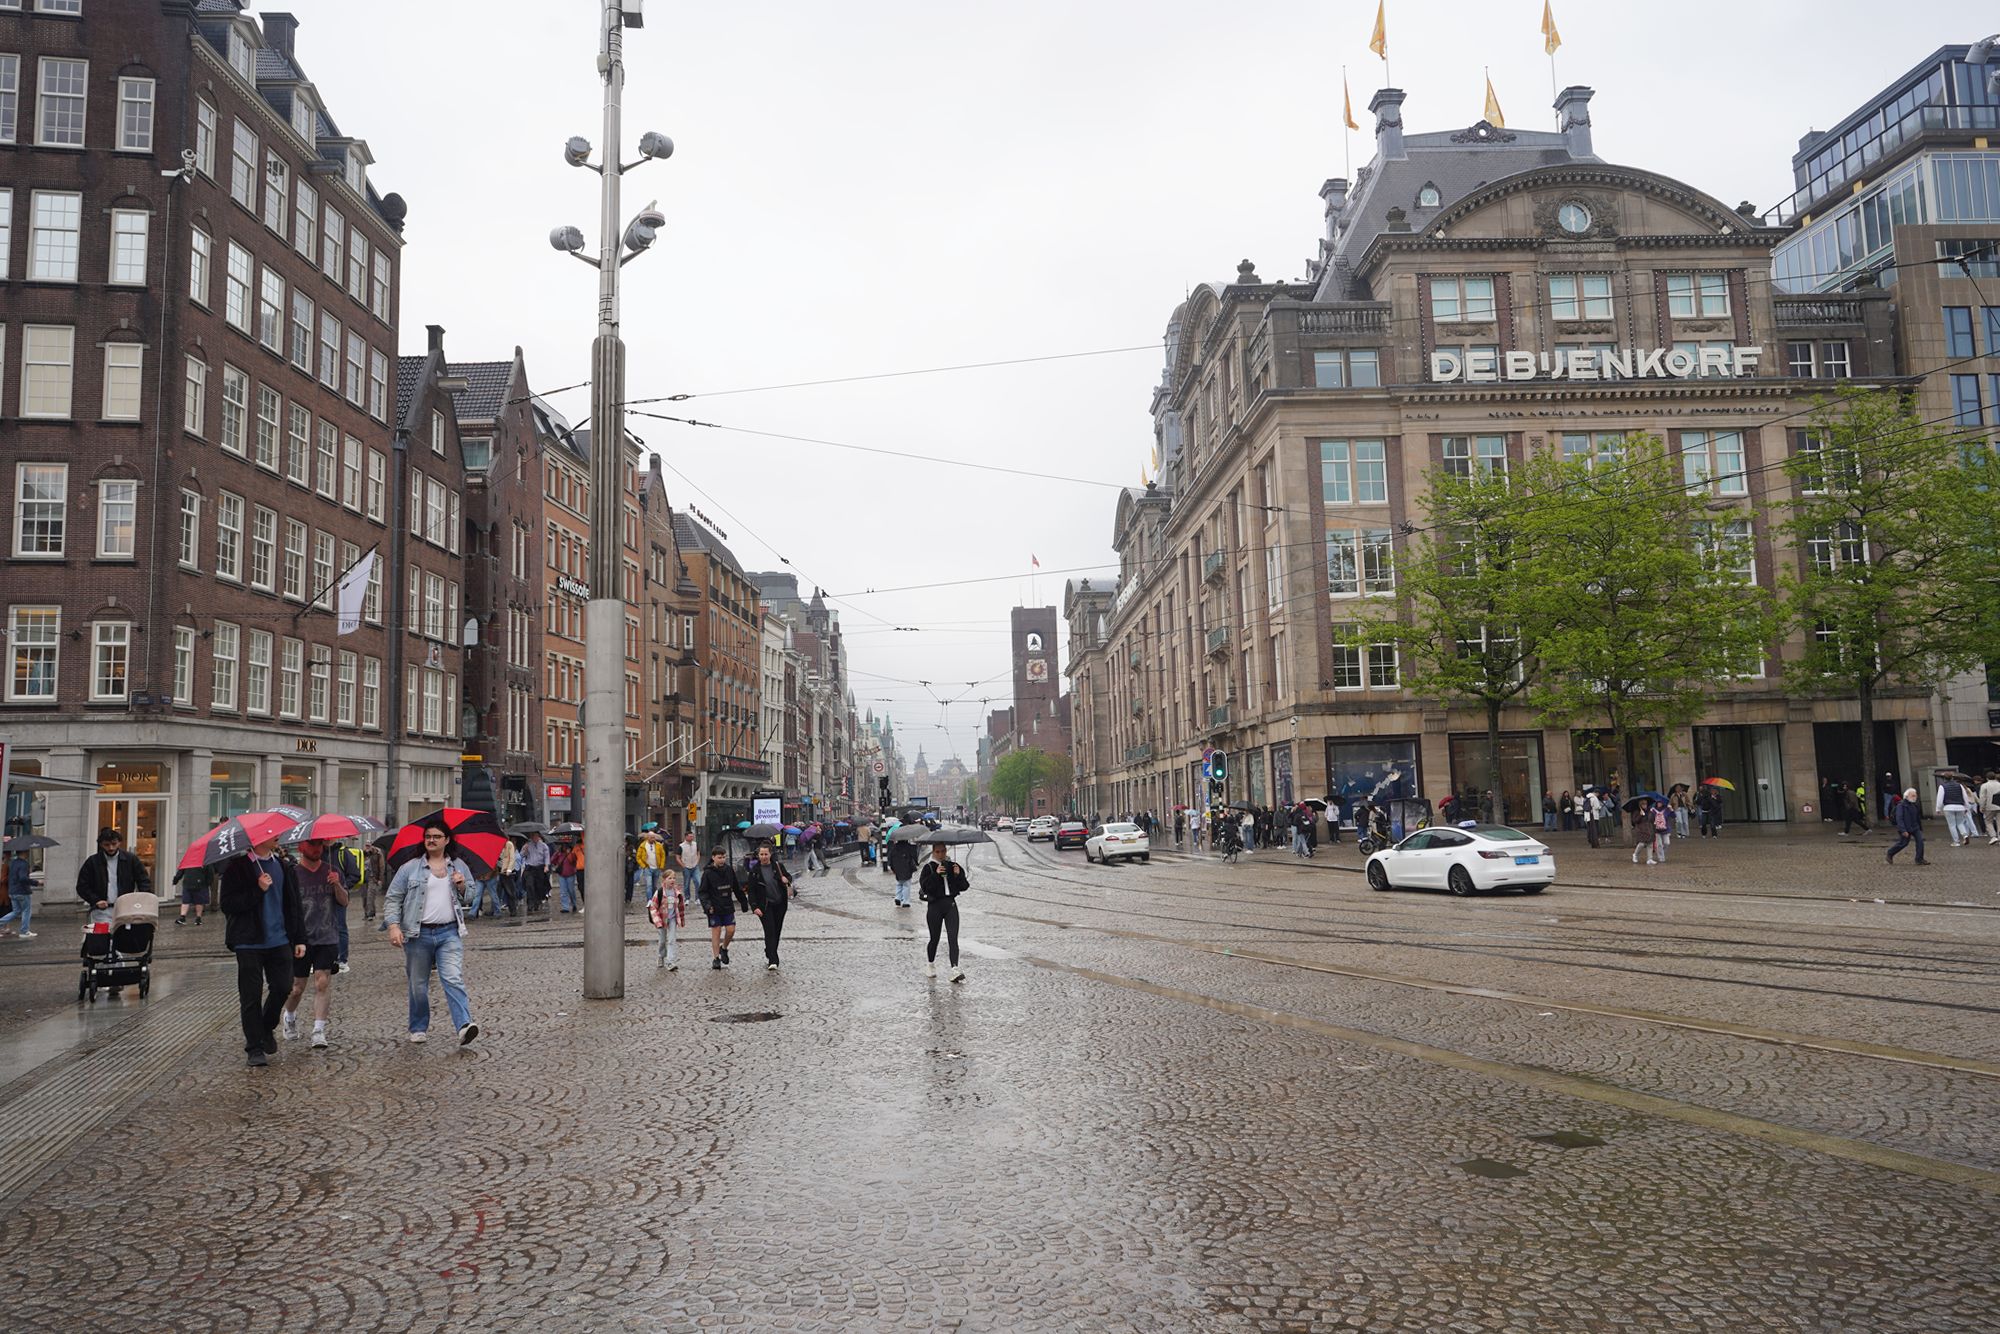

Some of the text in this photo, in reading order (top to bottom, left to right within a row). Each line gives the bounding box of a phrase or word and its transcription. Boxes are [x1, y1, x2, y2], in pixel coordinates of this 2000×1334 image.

[1431, 347, 1763, 382] DE BIJENKORF
[296, 738, 317, 752] DIOR
[116, 771, 151, 783] DIOR
